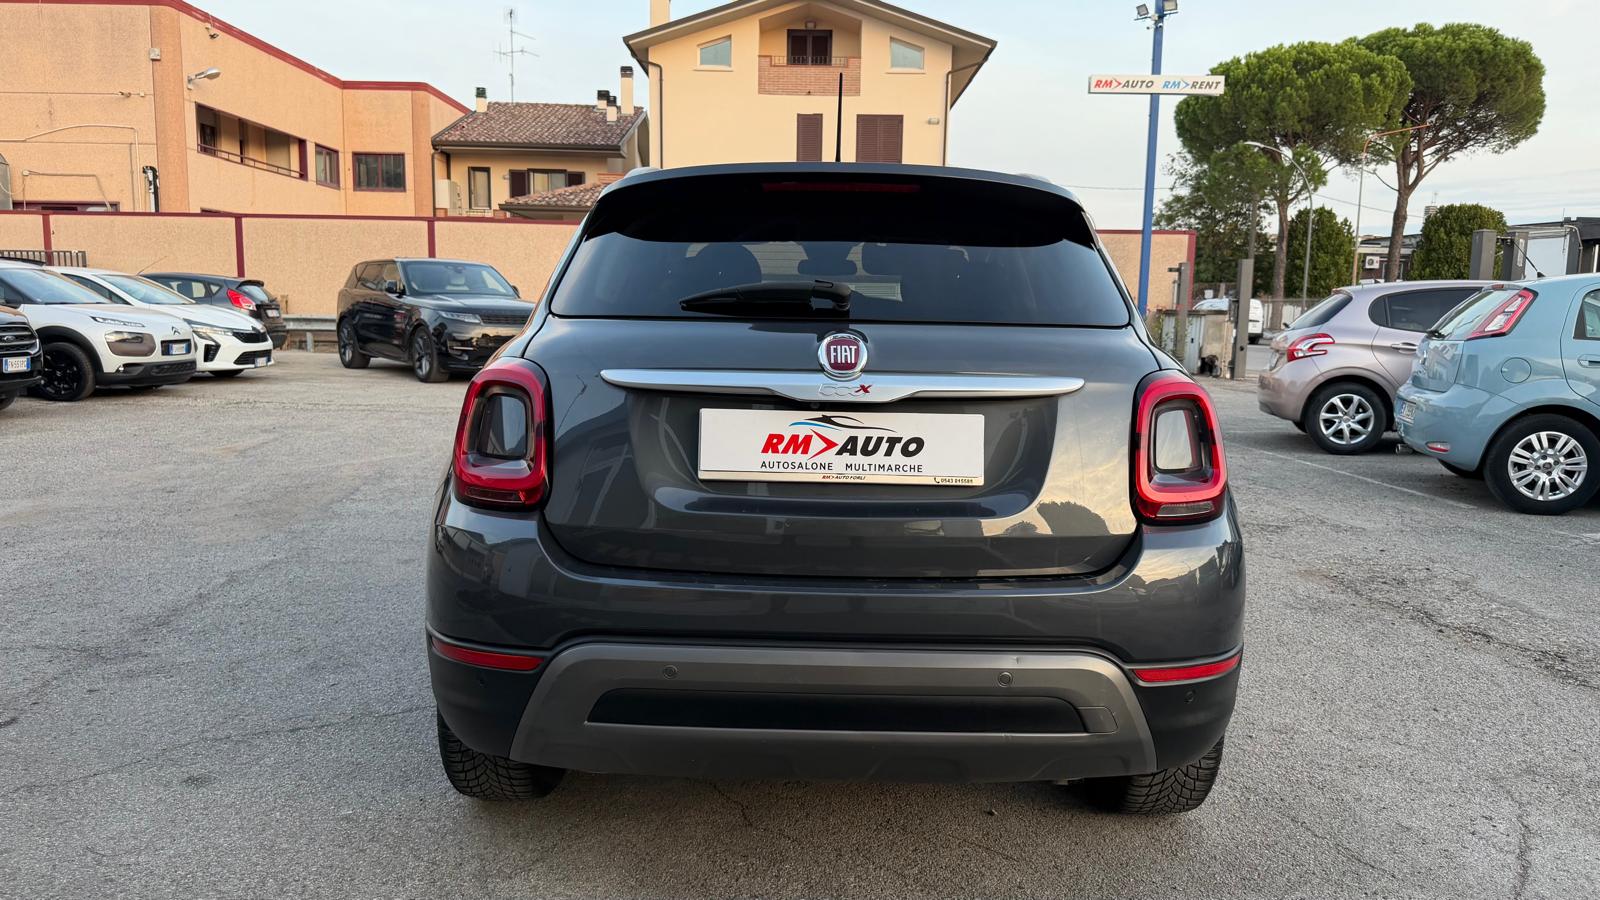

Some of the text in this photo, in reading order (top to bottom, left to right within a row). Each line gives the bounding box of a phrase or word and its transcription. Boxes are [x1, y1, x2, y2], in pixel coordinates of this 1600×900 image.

[830, 345, 857, 364] FIAT
[760, 461, 923, 472] AUTOSALONE MULTIMARCHE
